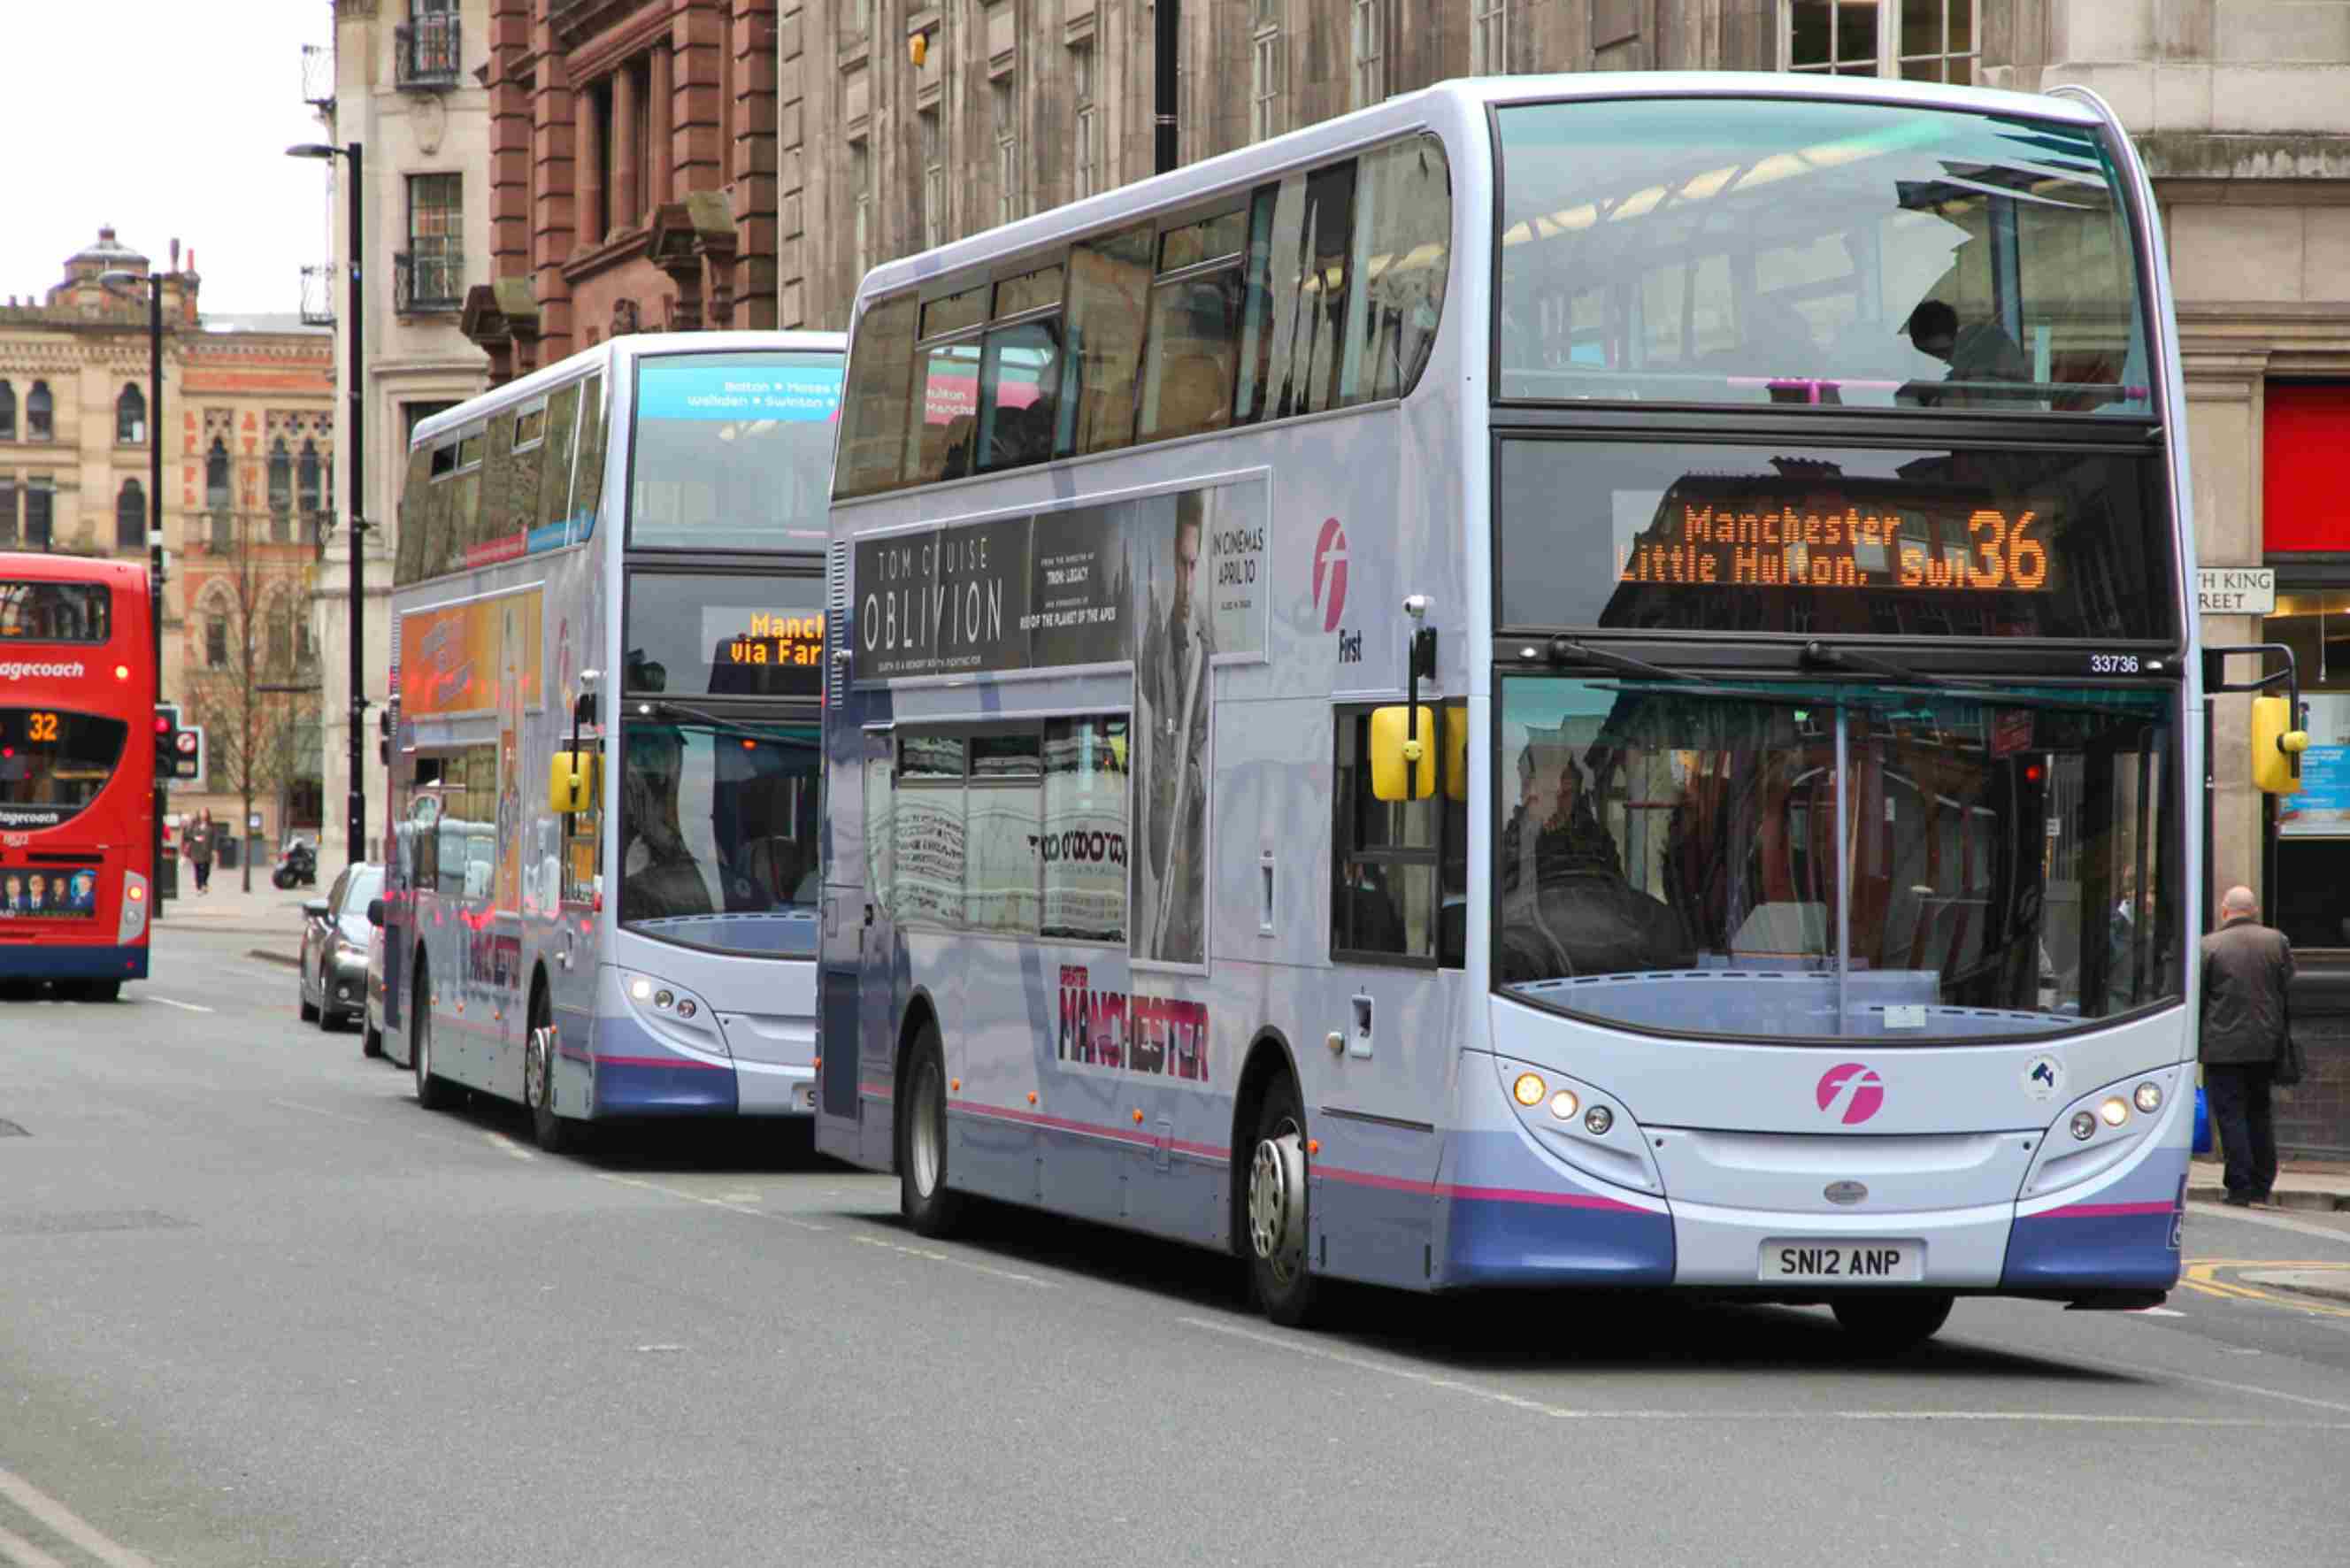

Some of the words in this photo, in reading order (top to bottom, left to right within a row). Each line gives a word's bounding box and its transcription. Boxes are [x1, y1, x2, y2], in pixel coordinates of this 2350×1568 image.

[1684, 504, 1901, 545] Manchester
[879, 548, 911, 581] TOM
[1619, 544, 1717, 583] Little
[1968, 510, 2047, 588] 36
[2223, 573, 2271, 589] KING
[864, 578, 1003, 652] OBLIVION
[731, 638, 766, 665] via
[779, 638, 822, 665] Far
[1339, 628, 1362, 663] First
[2091, 654, 2139, 673] 33736
[29, 712, 58, 742] 32
[1058, 987, 1210, 1083] MANCHESTER
[1780, 1249, 1841, 1275] SN12
[1848, 1249, 1901, 1275] ANP
